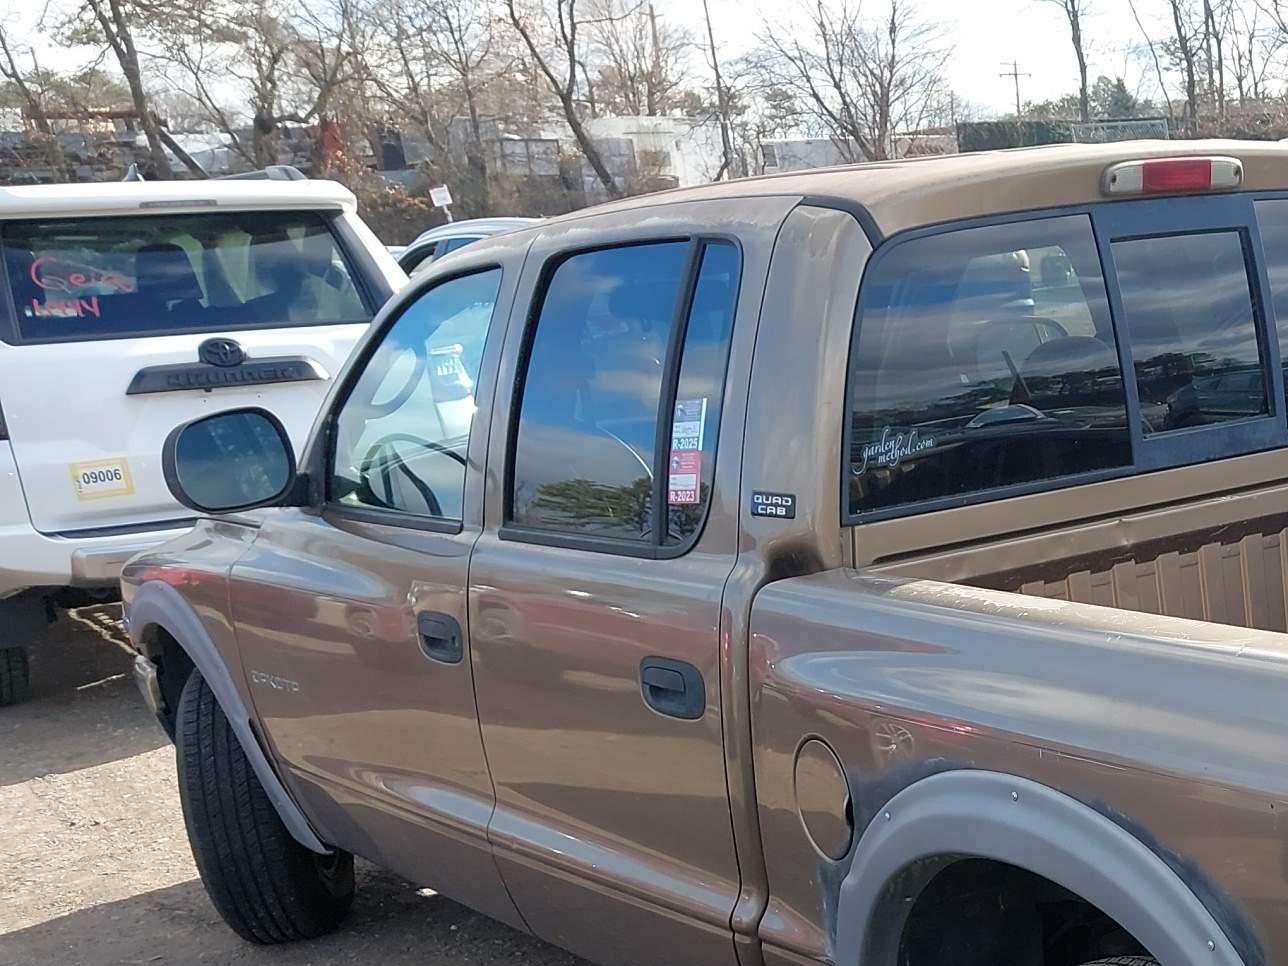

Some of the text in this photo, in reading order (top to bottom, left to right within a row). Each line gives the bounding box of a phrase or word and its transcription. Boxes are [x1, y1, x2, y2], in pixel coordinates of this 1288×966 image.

[672, 438, 698, 450] R-2025
[82, 468, 122, 485] 09006
[669, 491, 695, 502] R-2023
[754, 494, 792, 506] QUAD
[758, 505, 786, 516] CAB
